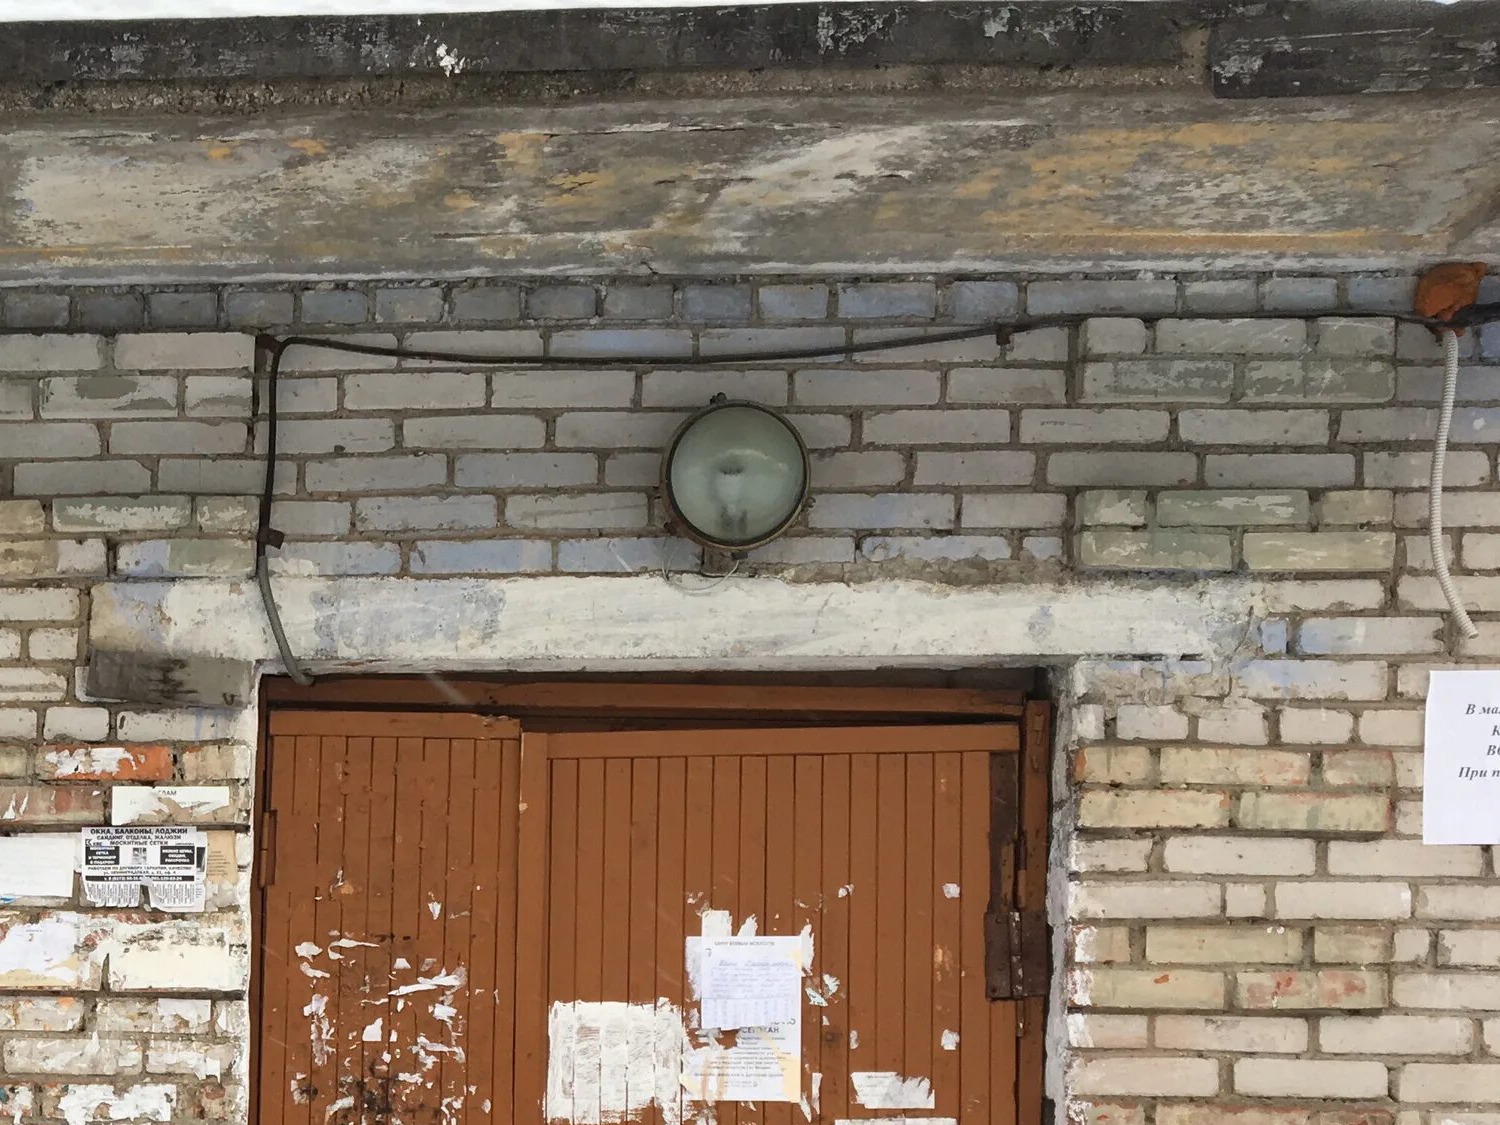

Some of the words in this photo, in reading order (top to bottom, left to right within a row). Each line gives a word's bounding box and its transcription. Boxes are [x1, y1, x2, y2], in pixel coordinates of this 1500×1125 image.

[1466, 704, 1476, 715] В
[1479, 706, 1500, 714] ма
[1458, 767, 1487, 780] При
